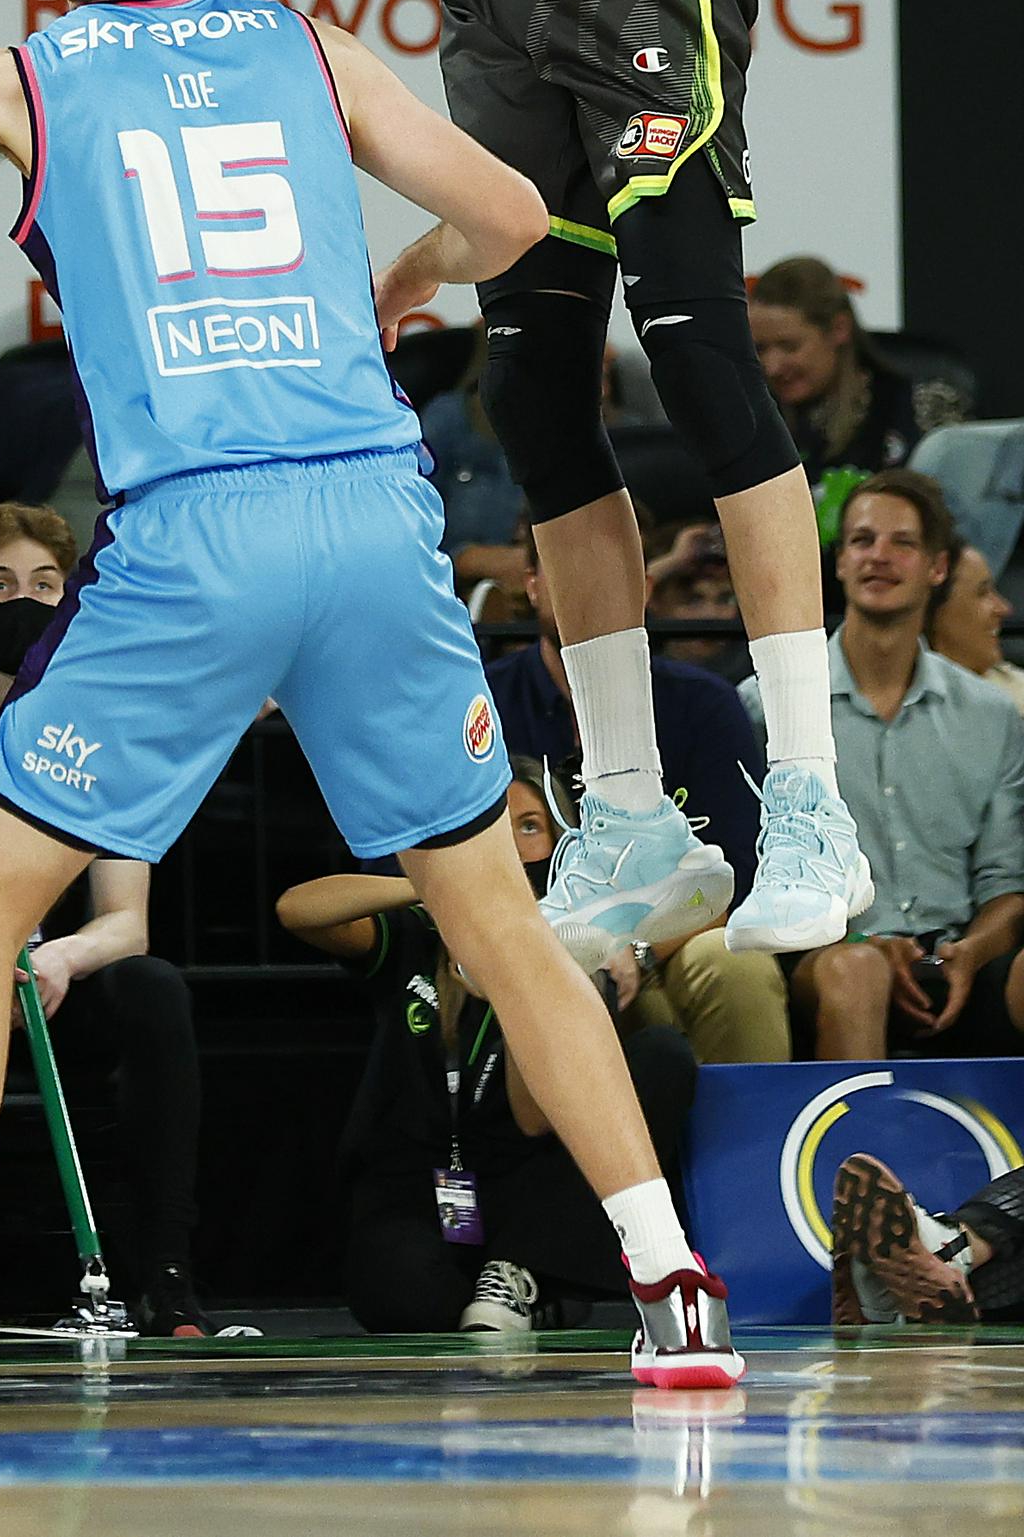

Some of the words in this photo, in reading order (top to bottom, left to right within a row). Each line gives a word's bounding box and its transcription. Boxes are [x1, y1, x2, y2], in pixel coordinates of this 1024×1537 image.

[150, 8, 279, 47] SPORT
[162, 71, 219, 110] LOE
[117, 120, 306, 284] 15
[166, 312, 304, 359] NEON
[21, 751, 97, 792] SPORT
